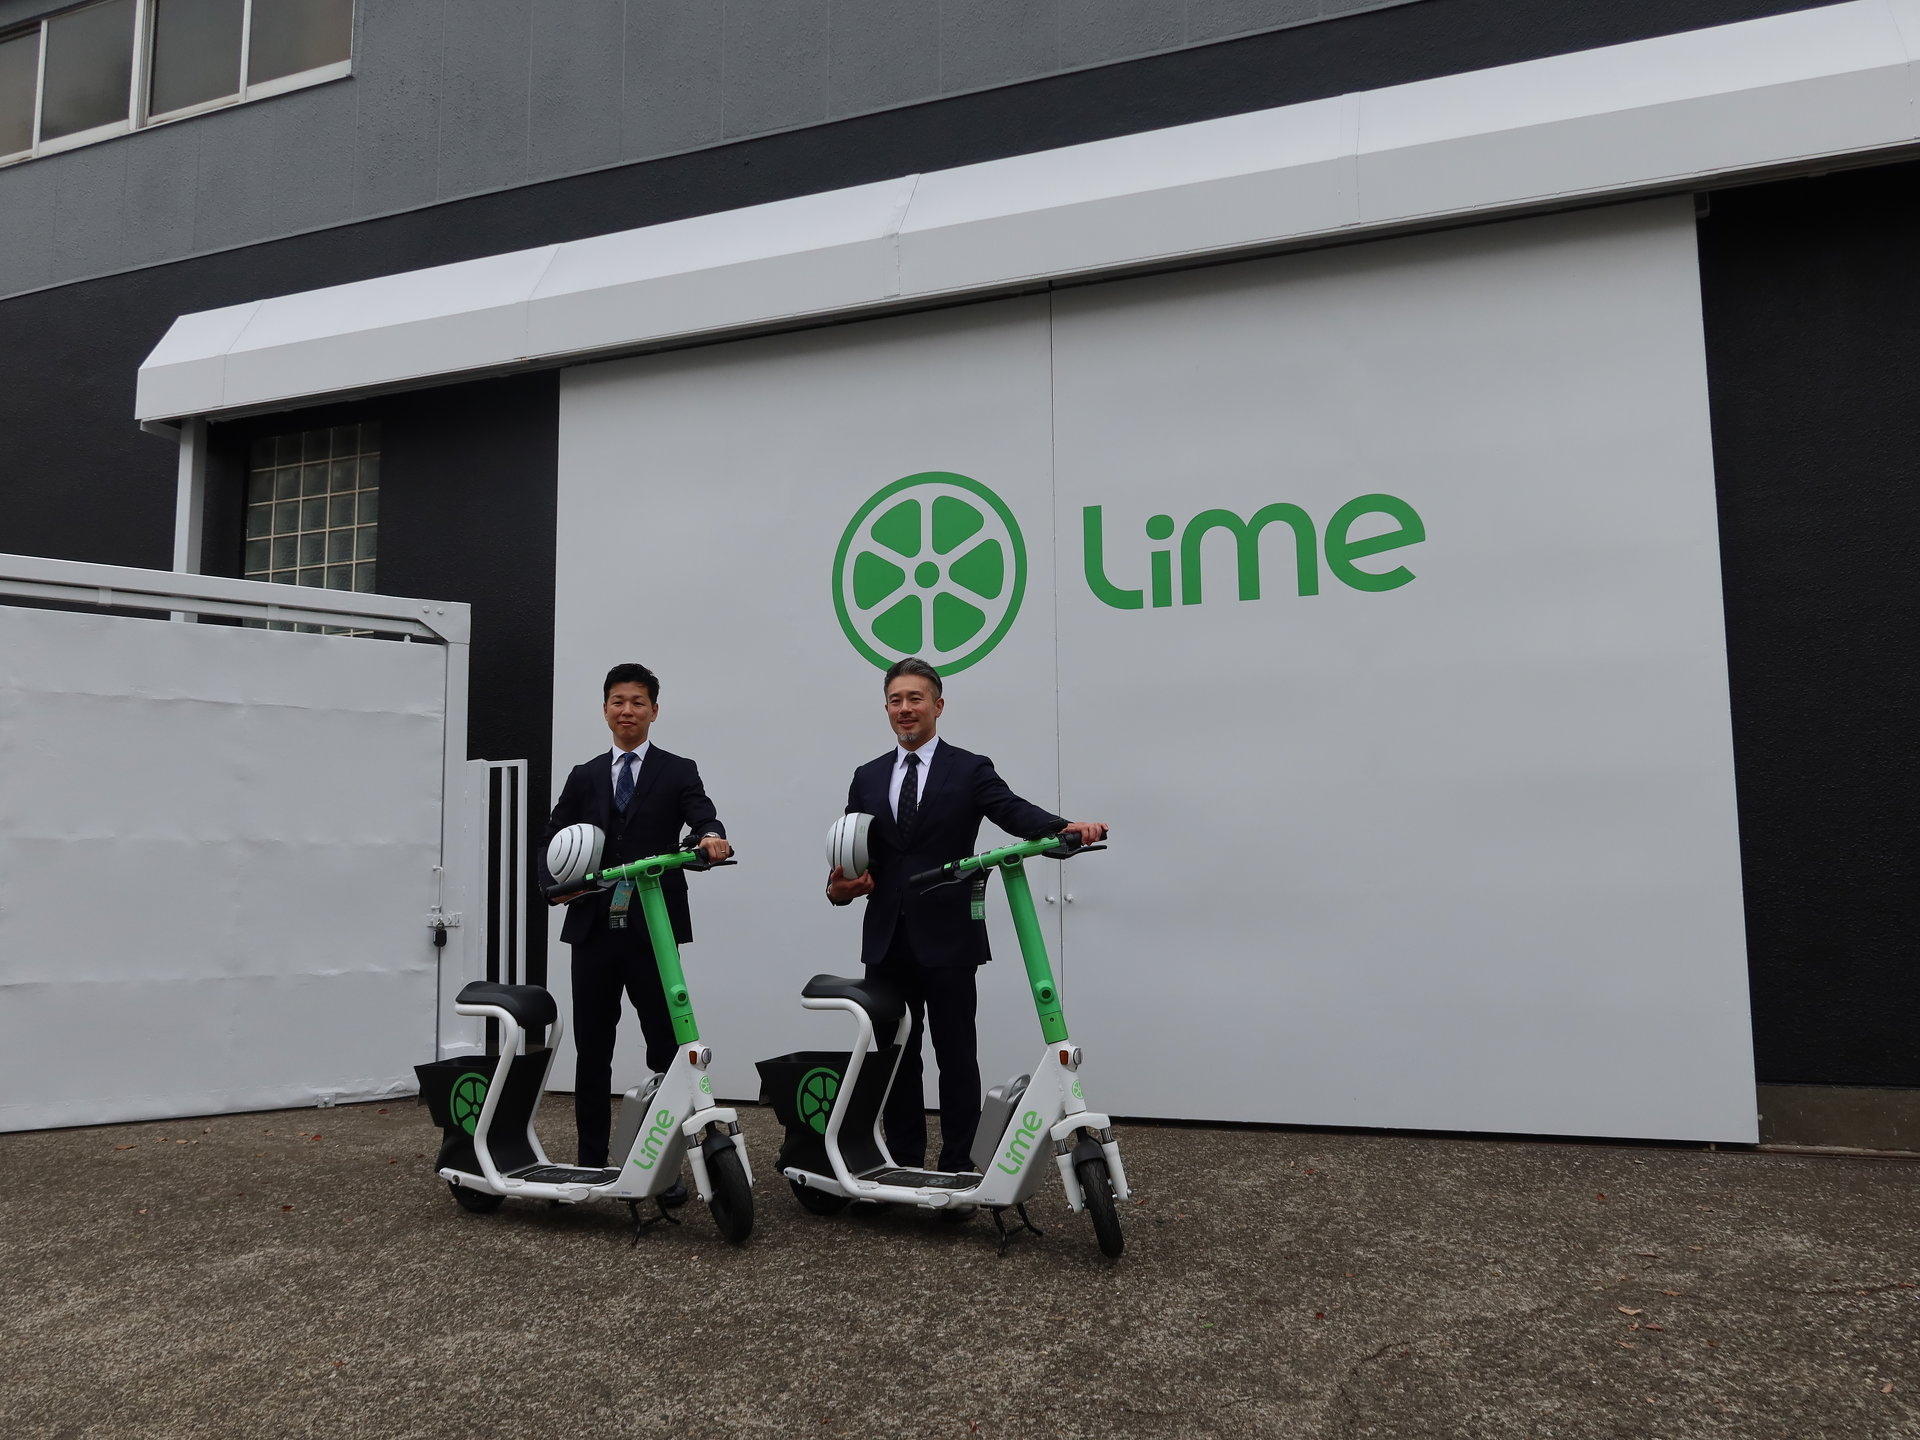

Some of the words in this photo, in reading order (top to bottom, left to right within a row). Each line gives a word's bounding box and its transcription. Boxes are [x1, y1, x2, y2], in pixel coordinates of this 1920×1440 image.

[1083, 493, 1426, 609] Lime
[633, 1109, 675, 1170] Lime
[997, 1110, 1043, 1175] Lime
